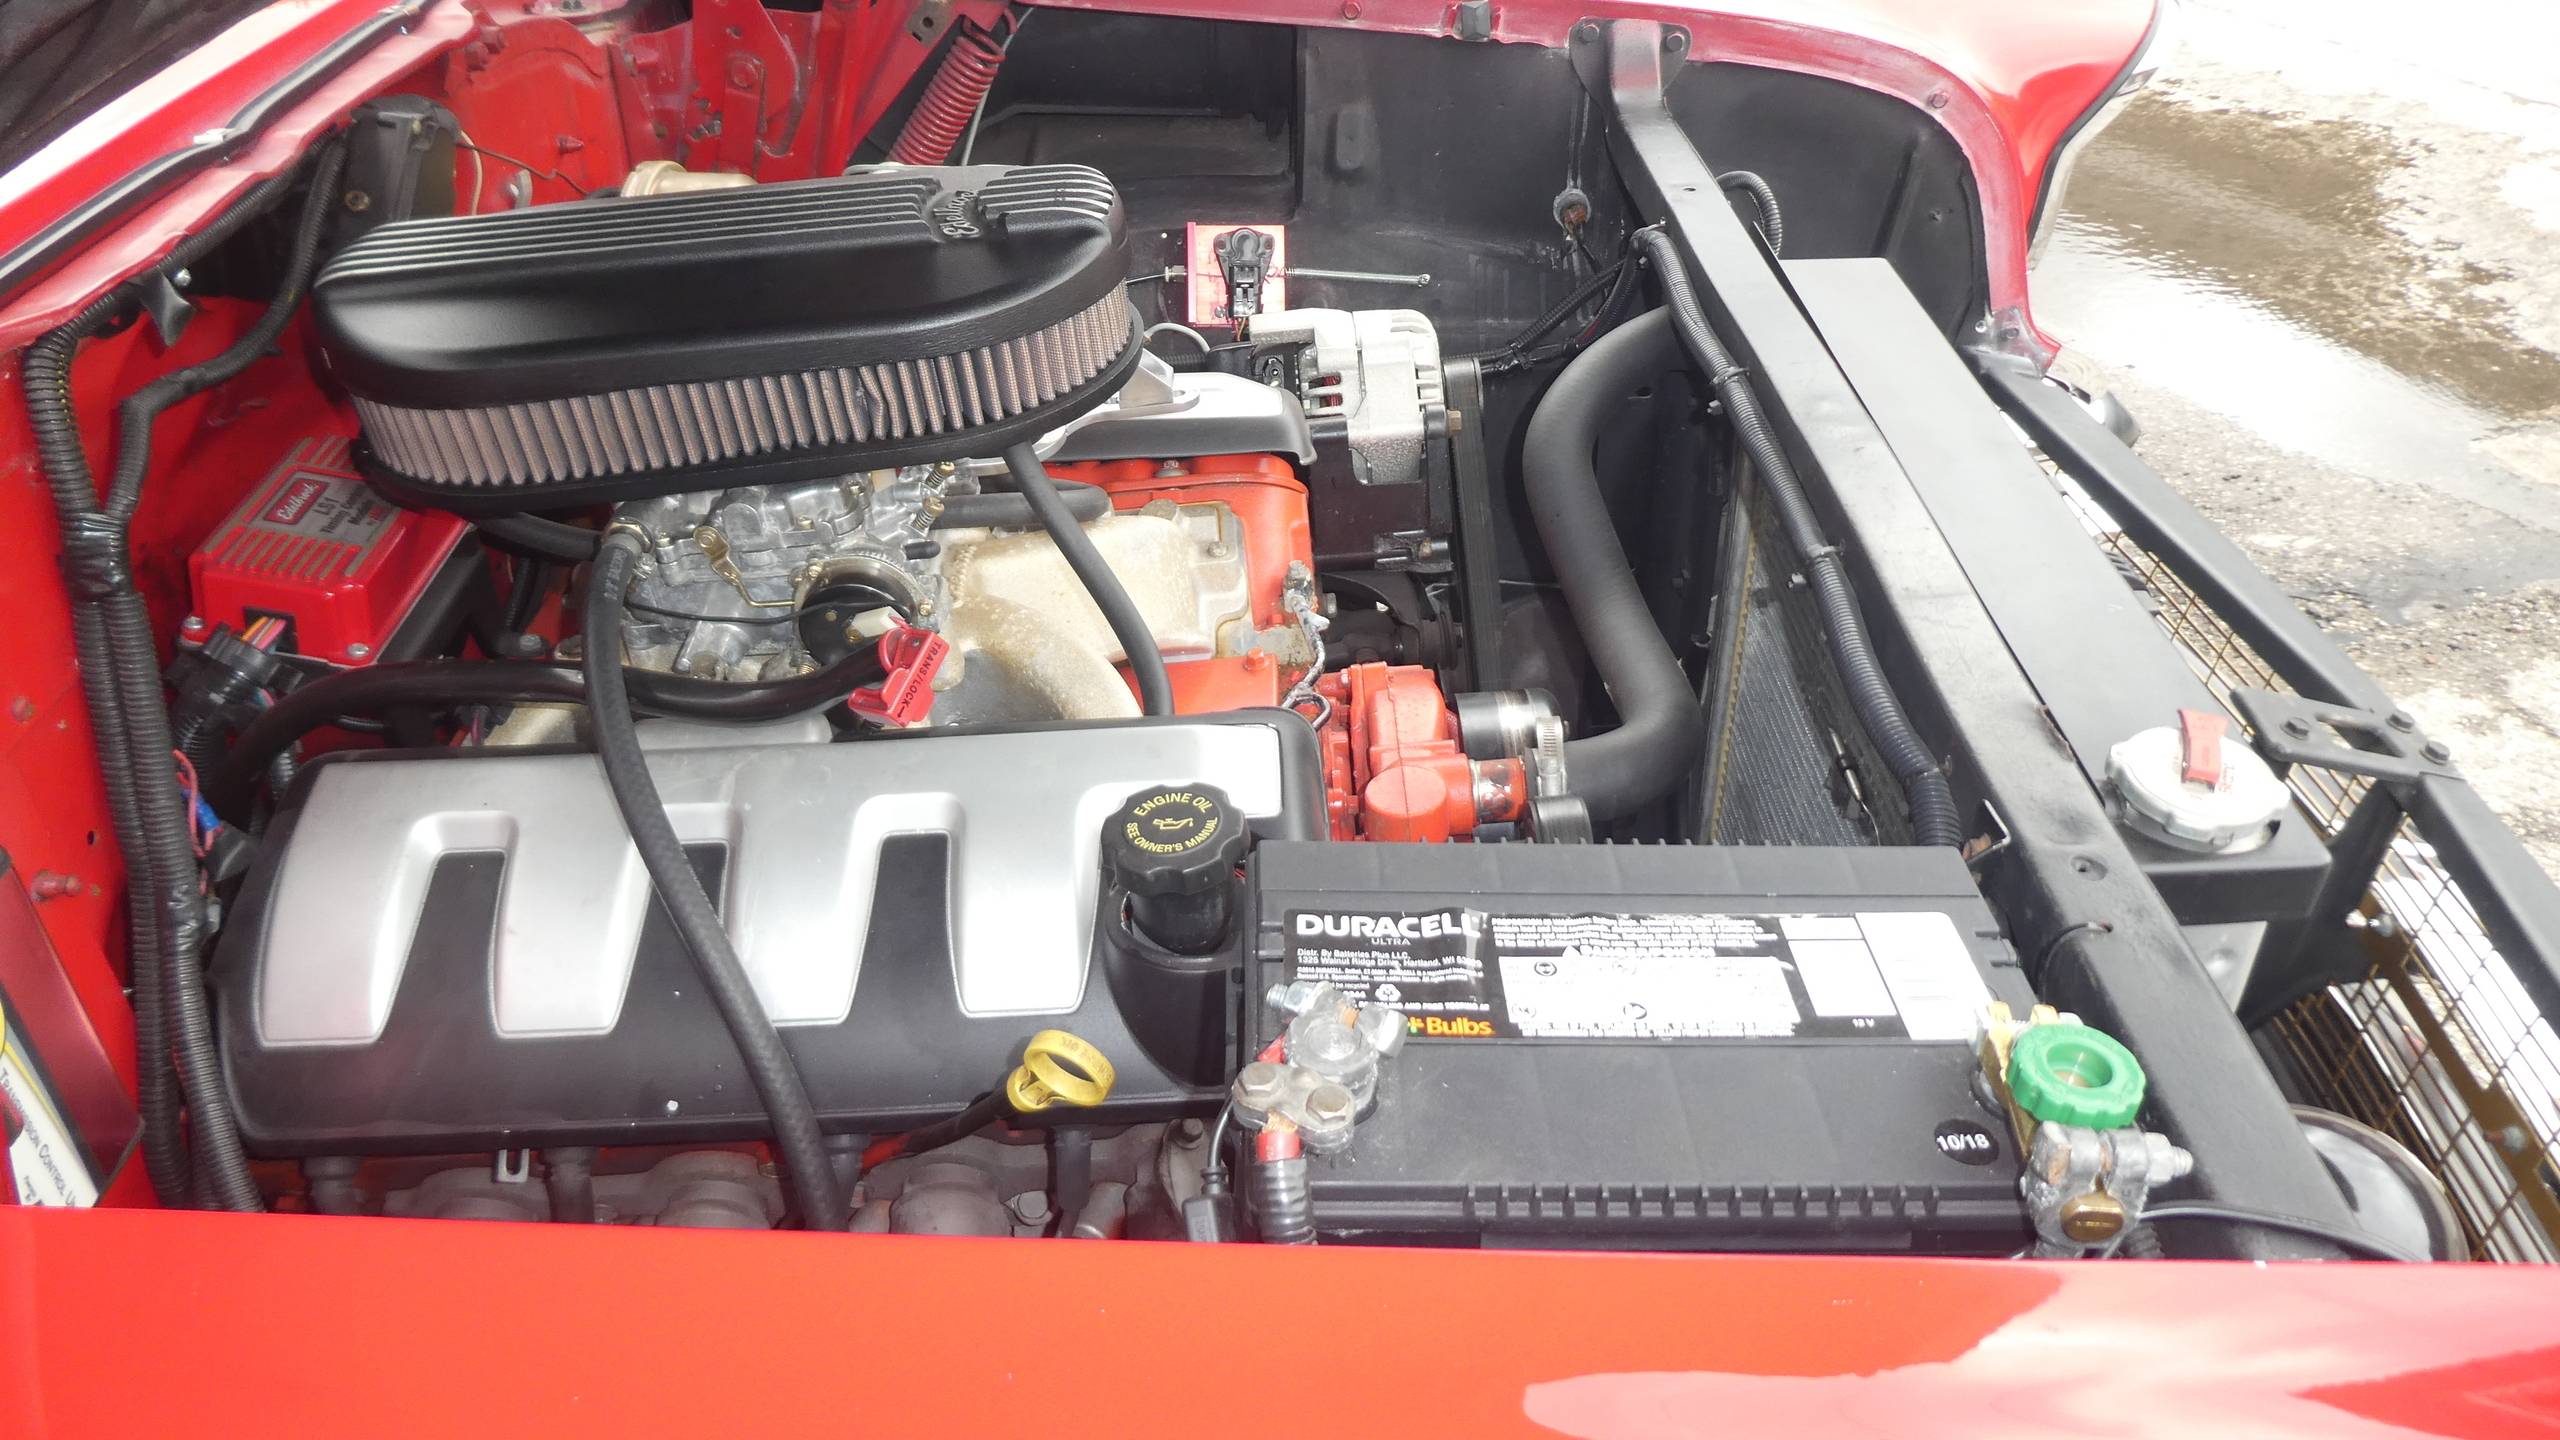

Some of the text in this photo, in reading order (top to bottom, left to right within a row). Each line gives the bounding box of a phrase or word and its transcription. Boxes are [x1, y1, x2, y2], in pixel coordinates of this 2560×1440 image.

[1133, 792, 1214, 817] ENGINE OIL
[1126, 817, 1219, 853] SEE OWNER'S MANUAL
[1296, 911, 1482, 938] DURACELL
[1371, 937, 1411, 946] ULTRA
[1320, 948, 1333, 958] By
[1333, 949, 1370, 958] Batteries
[1371, 950, 1390, 959] Plus
[1936, 1133, 1990, 1151] 10/18
